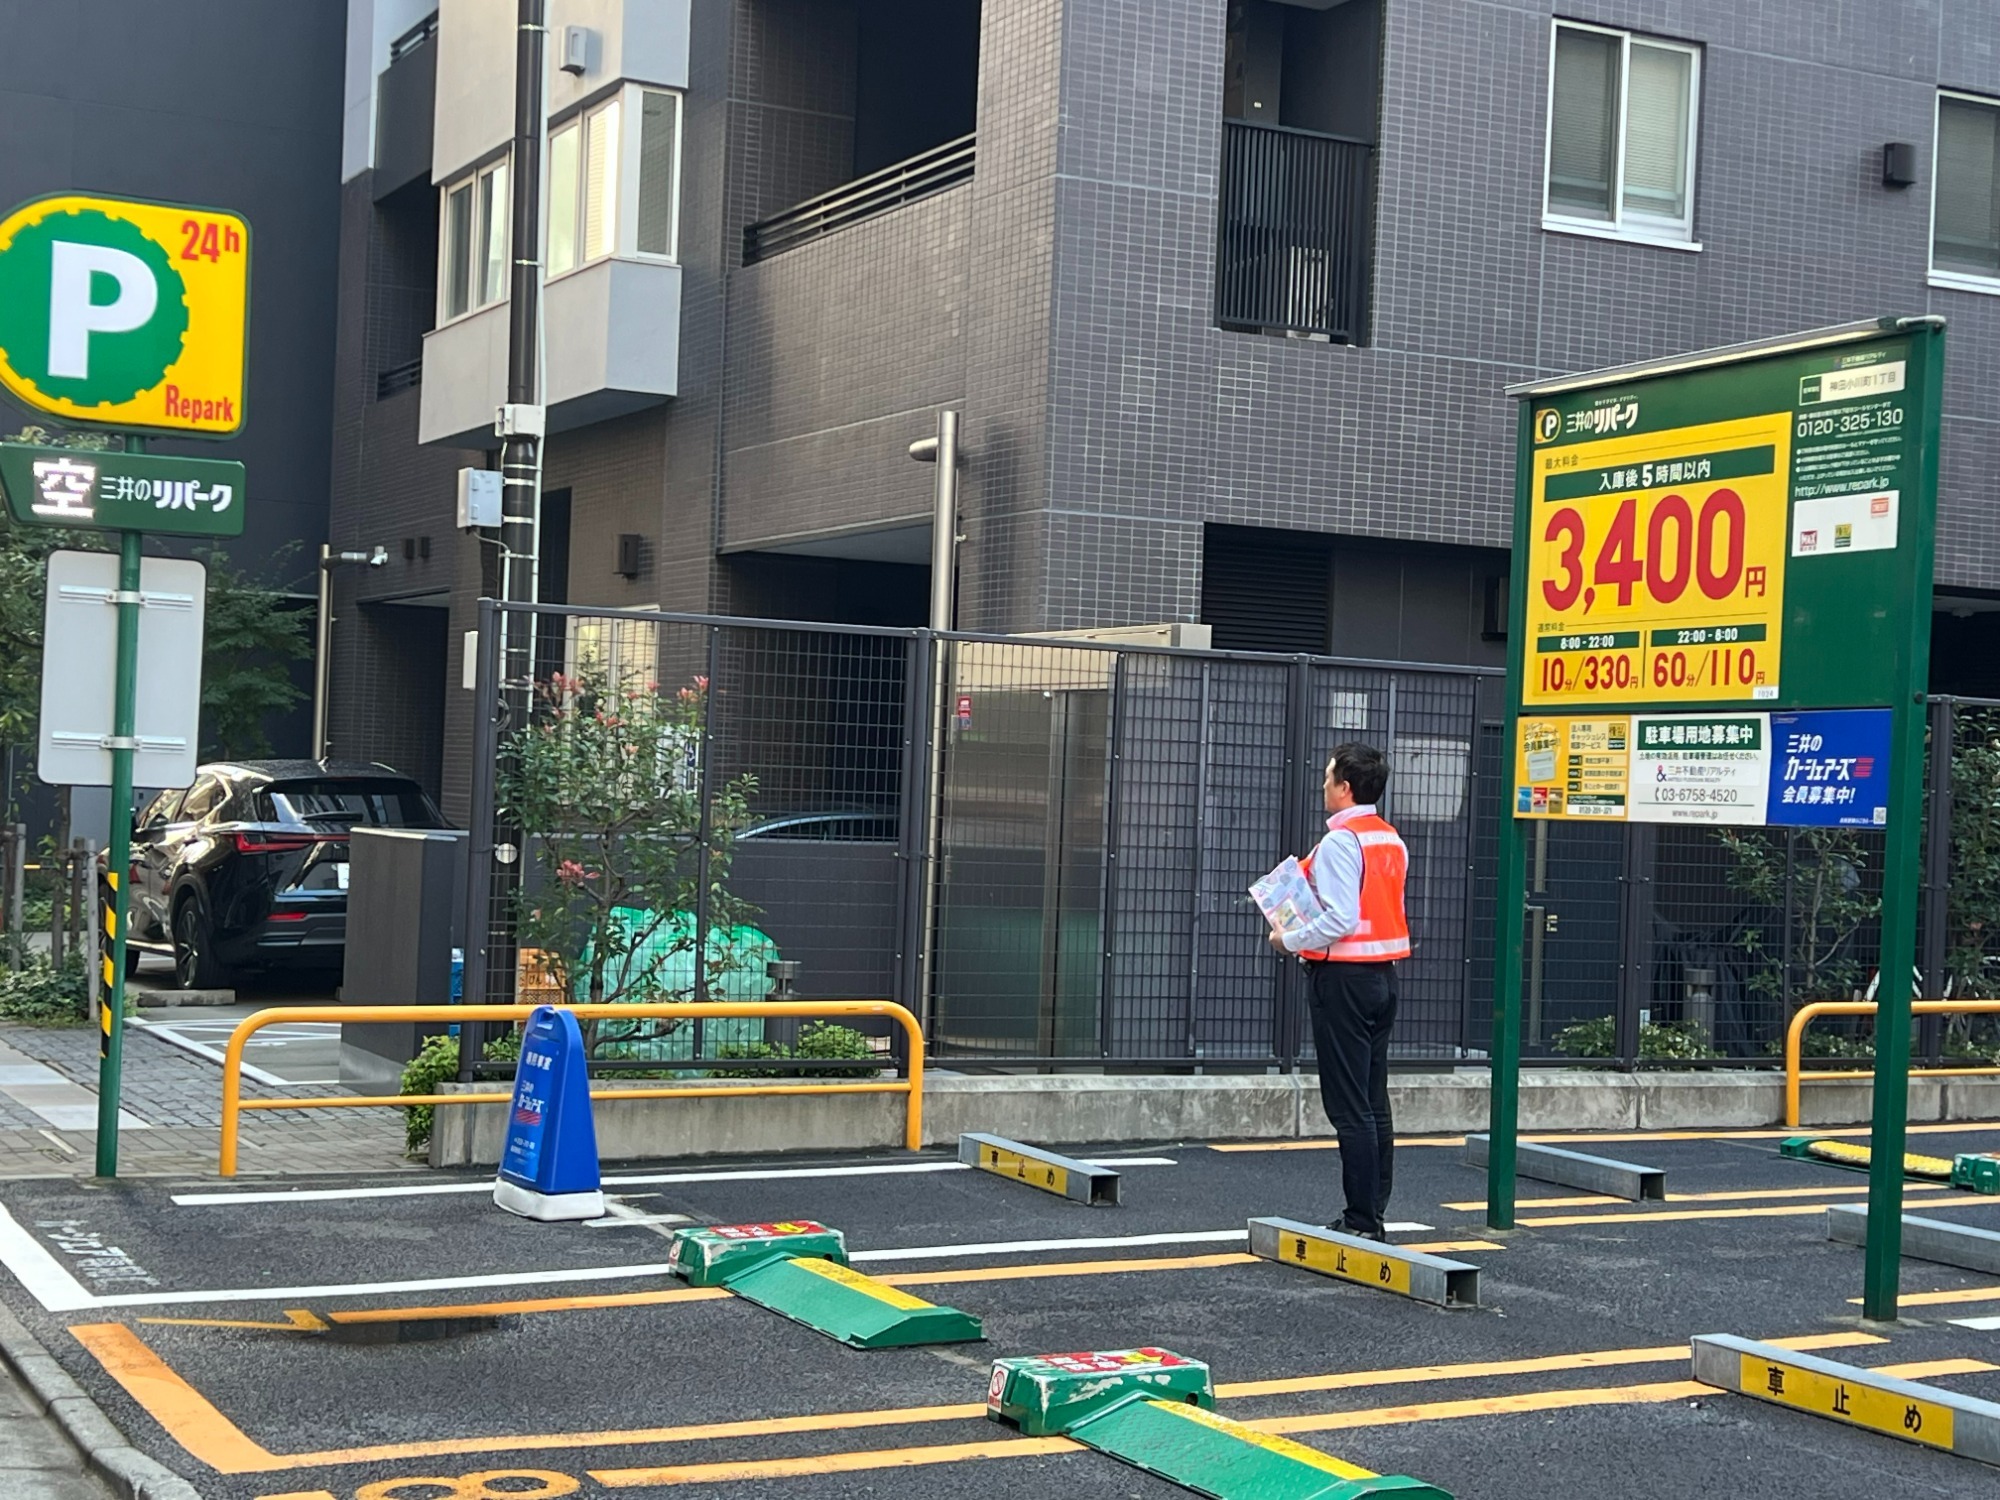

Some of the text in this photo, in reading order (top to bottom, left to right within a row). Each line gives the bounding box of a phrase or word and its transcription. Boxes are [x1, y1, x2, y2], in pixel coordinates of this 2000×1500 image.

[181, 220, 240, 263] 24h
[48, 240, 158, 379] P
[165, 385, 234, 423] Repark
[1566, 402, 1639, 434] 三井のリパーク
[1797, 408, 1904, 438] 0120-325-130
[31, 458, 96, 519] 空
[101, 476, 232, 512] 三井のリパーク
[1645, 724, 1753, 745] 駐車場用地募集中
[1786, 734, 1823, 753] 三井の
[1662, 788, 1737, 803] 03-6758-4520
